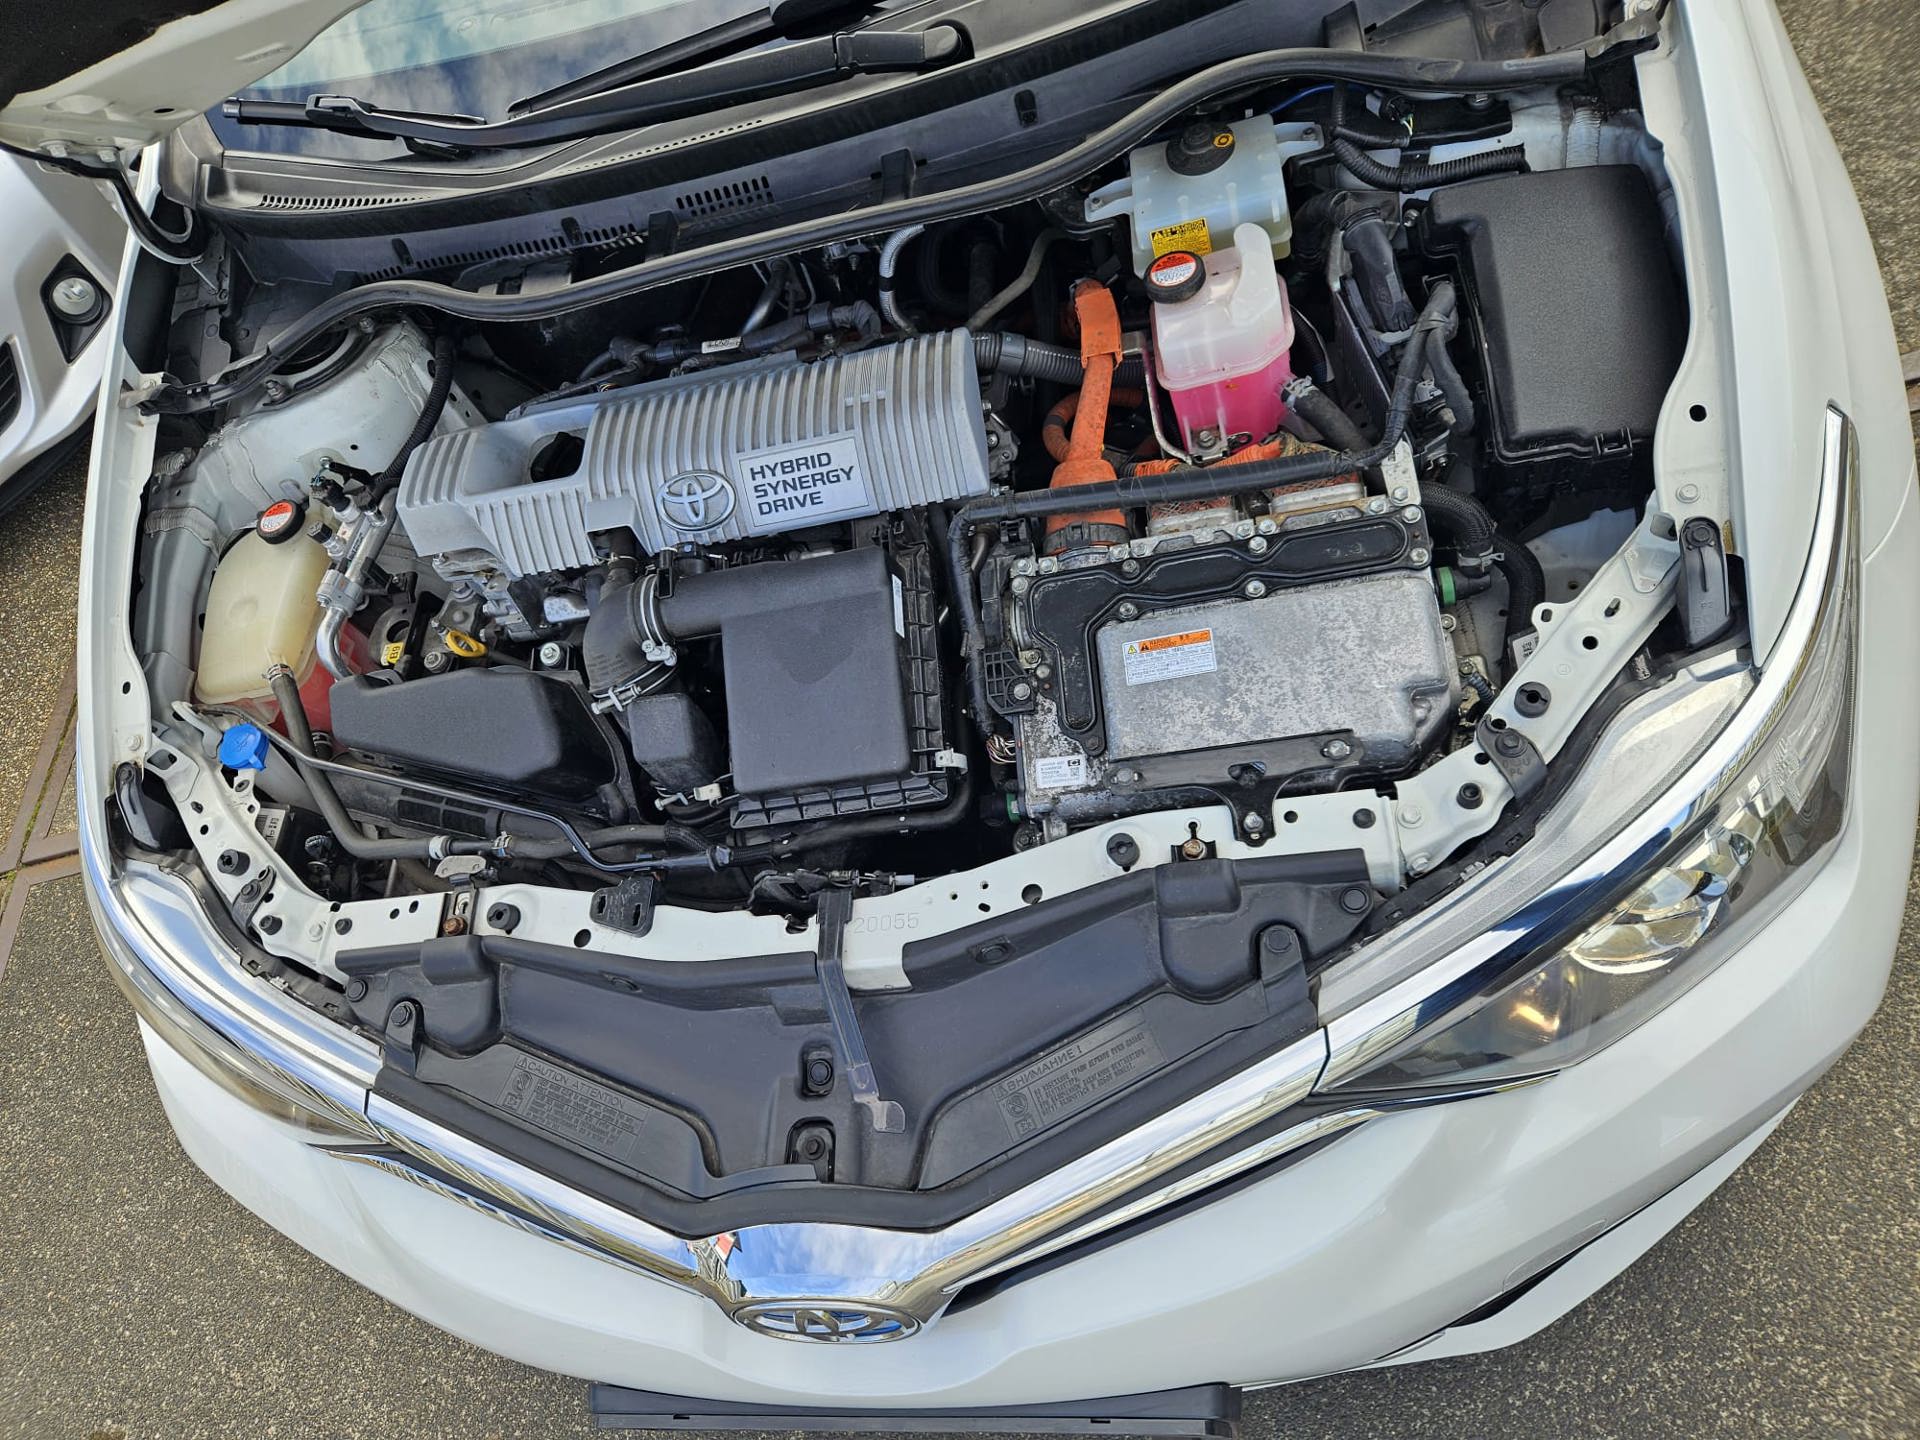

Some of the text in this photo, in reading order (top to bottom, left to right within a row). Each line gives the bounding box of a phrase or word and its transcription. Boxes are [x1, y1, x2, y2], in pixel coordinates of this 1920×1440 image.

[750, 452, 832, 481] HYBRID
[753, 466, 855, 499] SYNERGY
[757, 491, 824, 516] DRIVE
[854, 912, 920, 934] 20055
[528, 1062, 624, 1109] CAUTION ATTENTION
[1007, 1050, 1077, 1092] ВНИМАНИЕ
